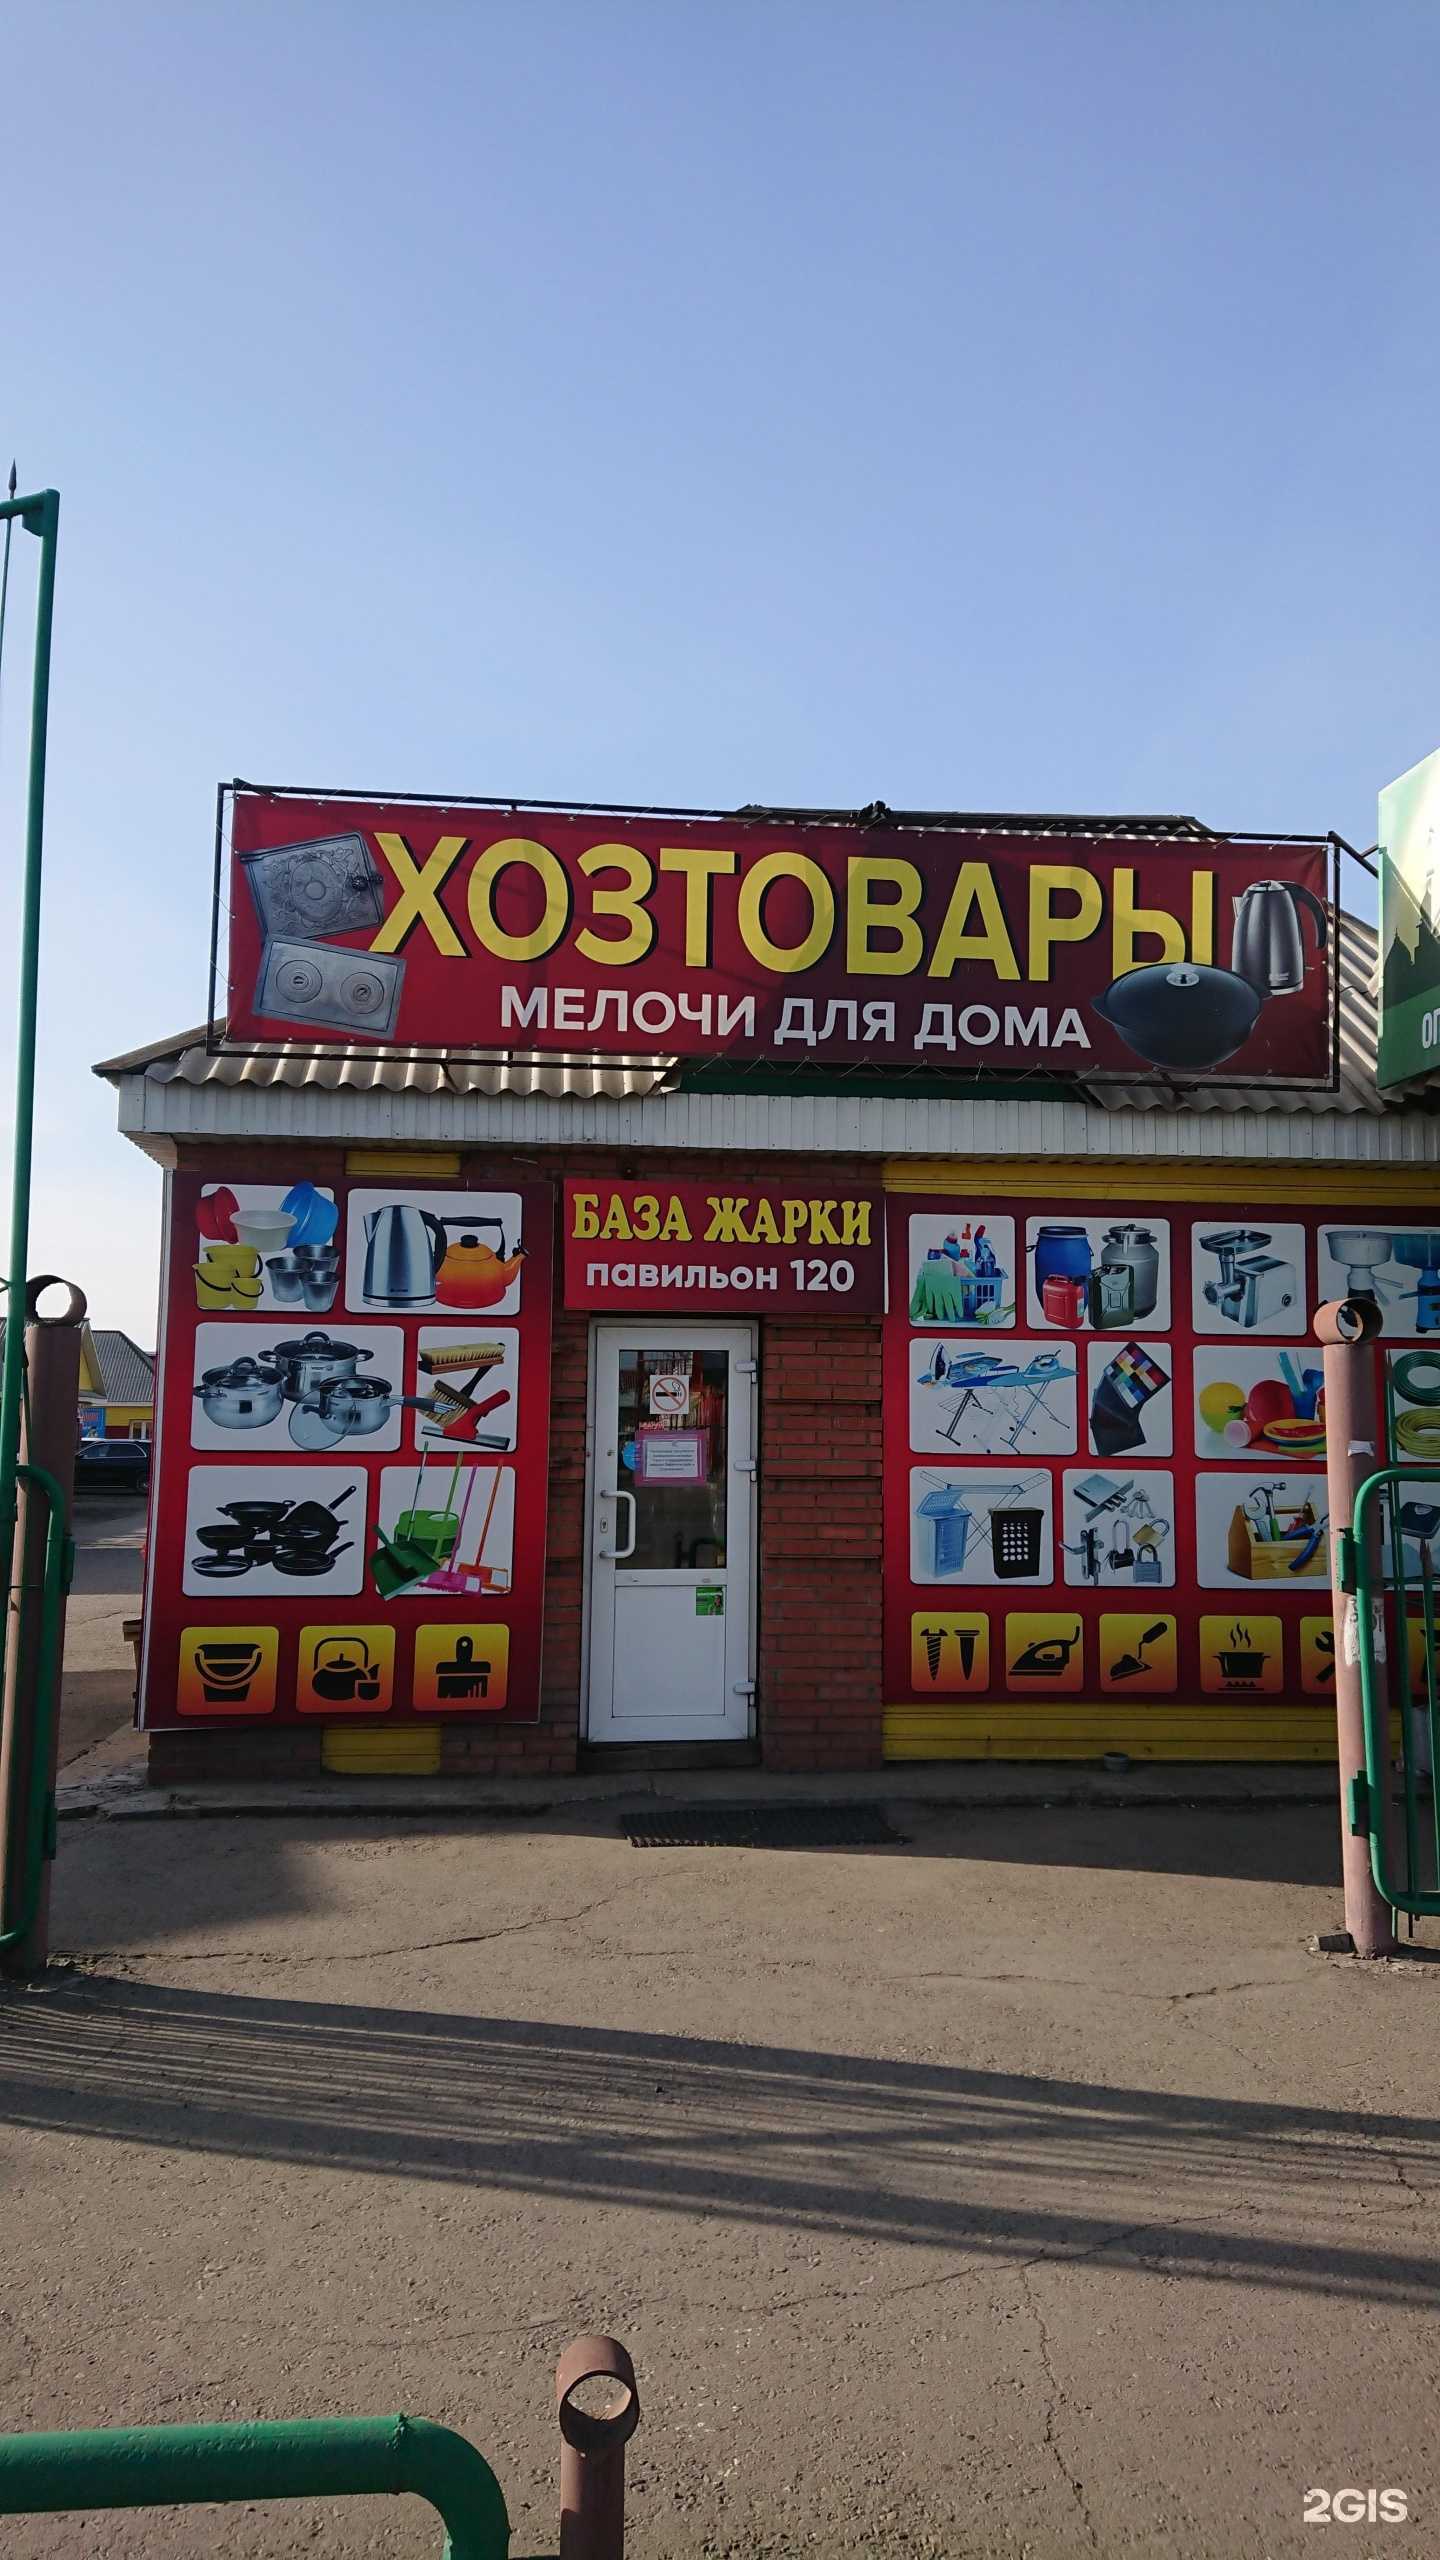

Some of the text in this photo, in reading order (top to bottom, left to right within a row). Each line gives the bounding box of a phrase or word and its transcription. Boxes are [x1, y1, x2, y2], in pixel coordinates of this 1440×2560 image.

[367, 831, 1214, 984] ХОЗТОВАРЫ
[500, 985, 1092, 1052] МЕЛОЧИ ДЛЯ ДОМА
[571, 1193, 873, 1246] БАЗА ЖАРКИ
[586, 1258, 856, 1293] павильон 120
